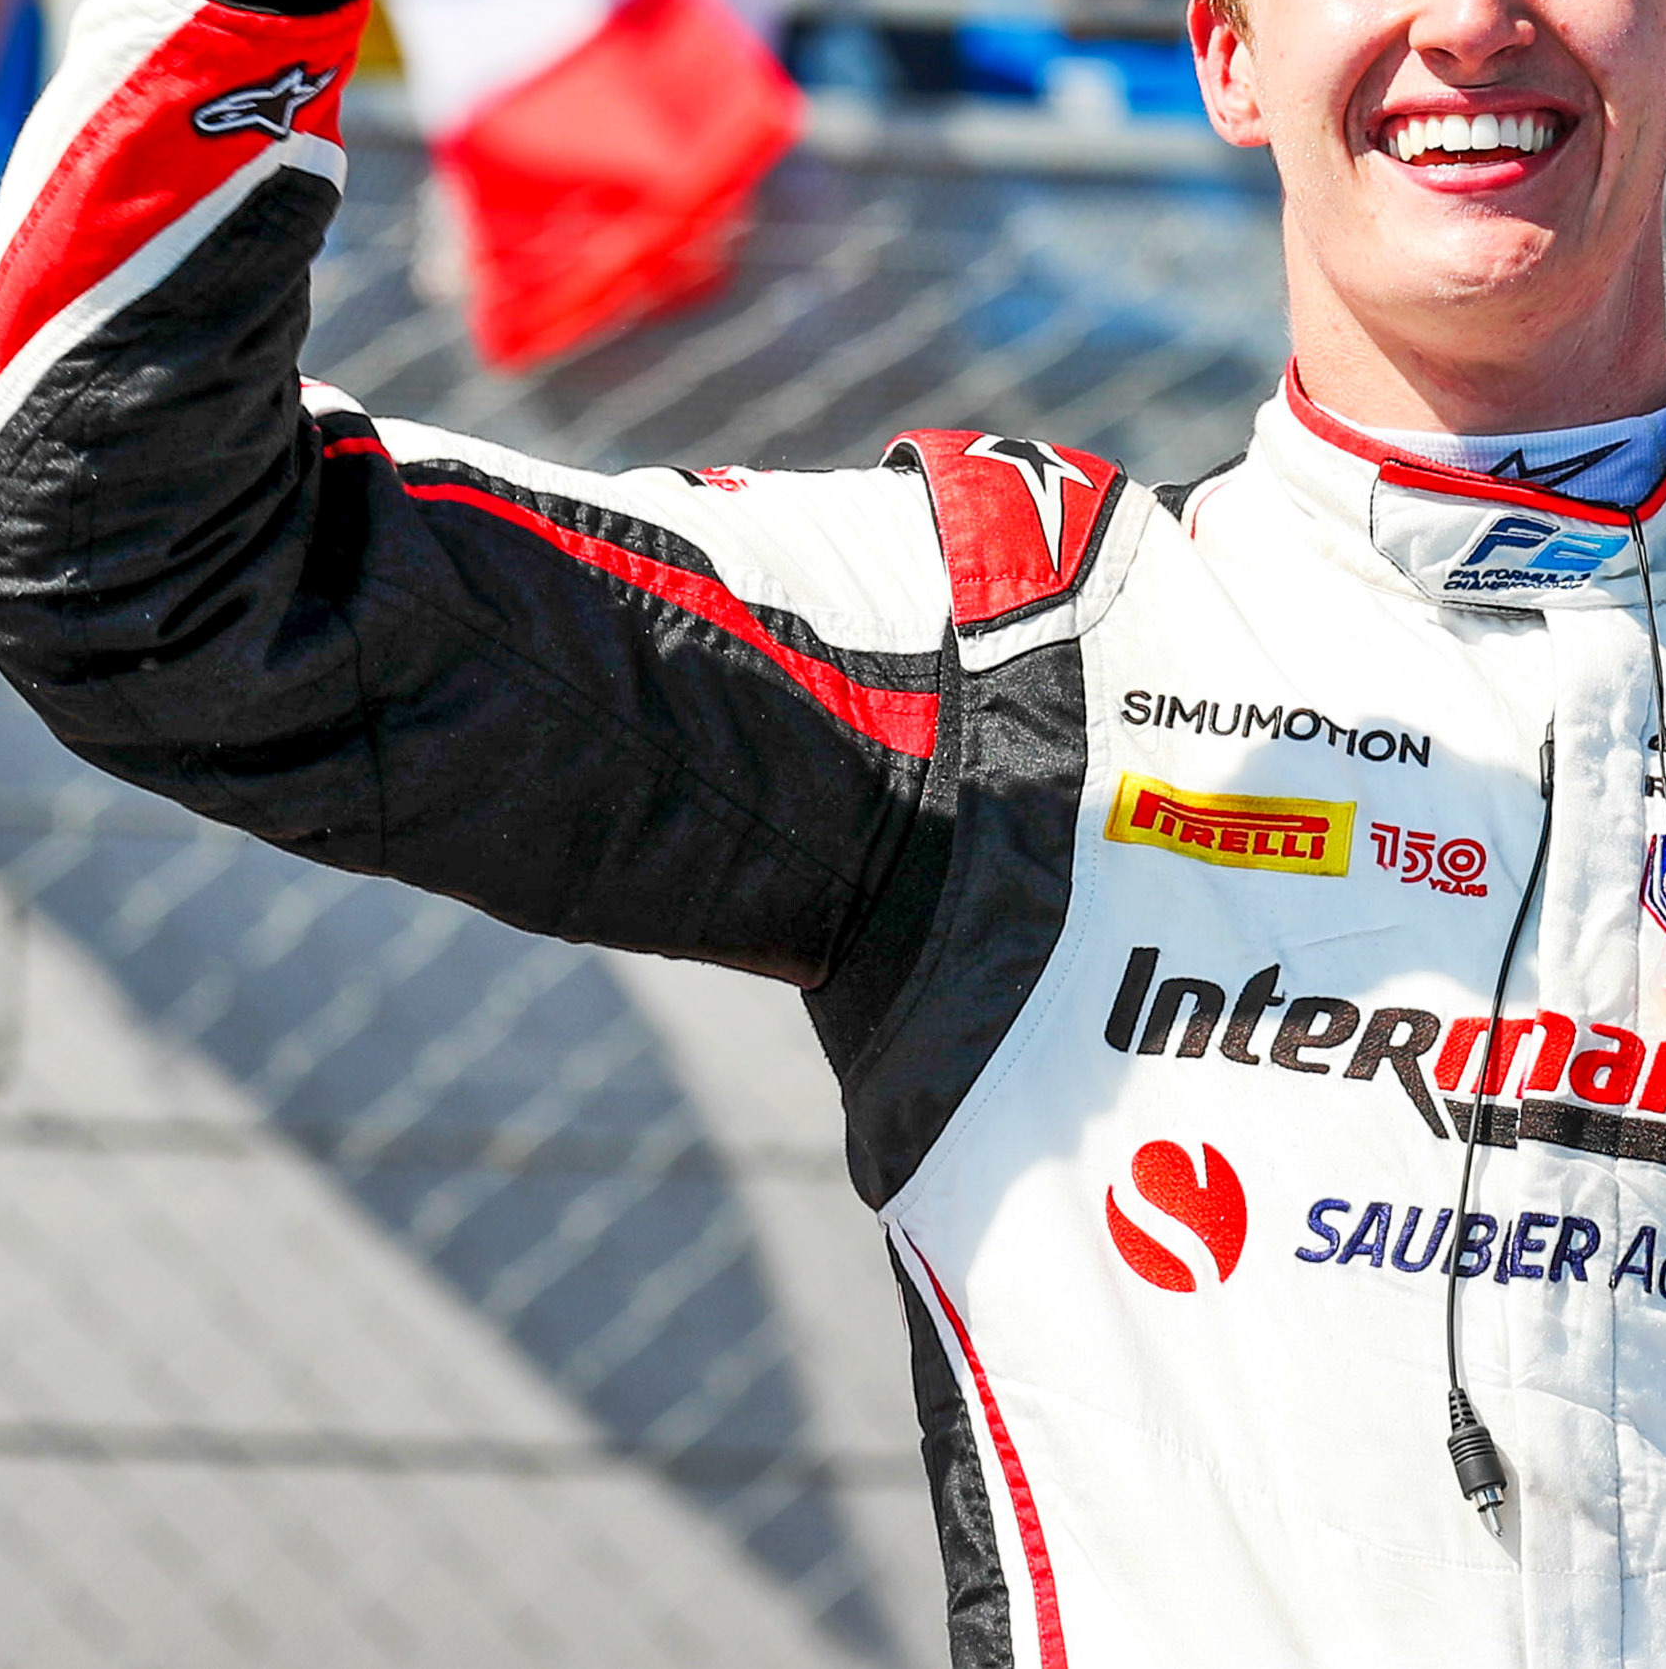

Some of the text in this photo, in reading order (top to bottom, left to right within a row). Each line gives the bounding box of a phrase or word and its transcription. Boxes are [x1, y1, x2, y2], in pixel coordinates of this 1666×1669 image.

[1121, 689, 1431, 768] SIMUMOTION
[1130, 789, 1330, 861] PIRELLI
[1370, 821, 1488, 884] 150
[1428, 877, 1488, 898] YEARS
[1295, 1198, 1602, 1288] SAUBER
